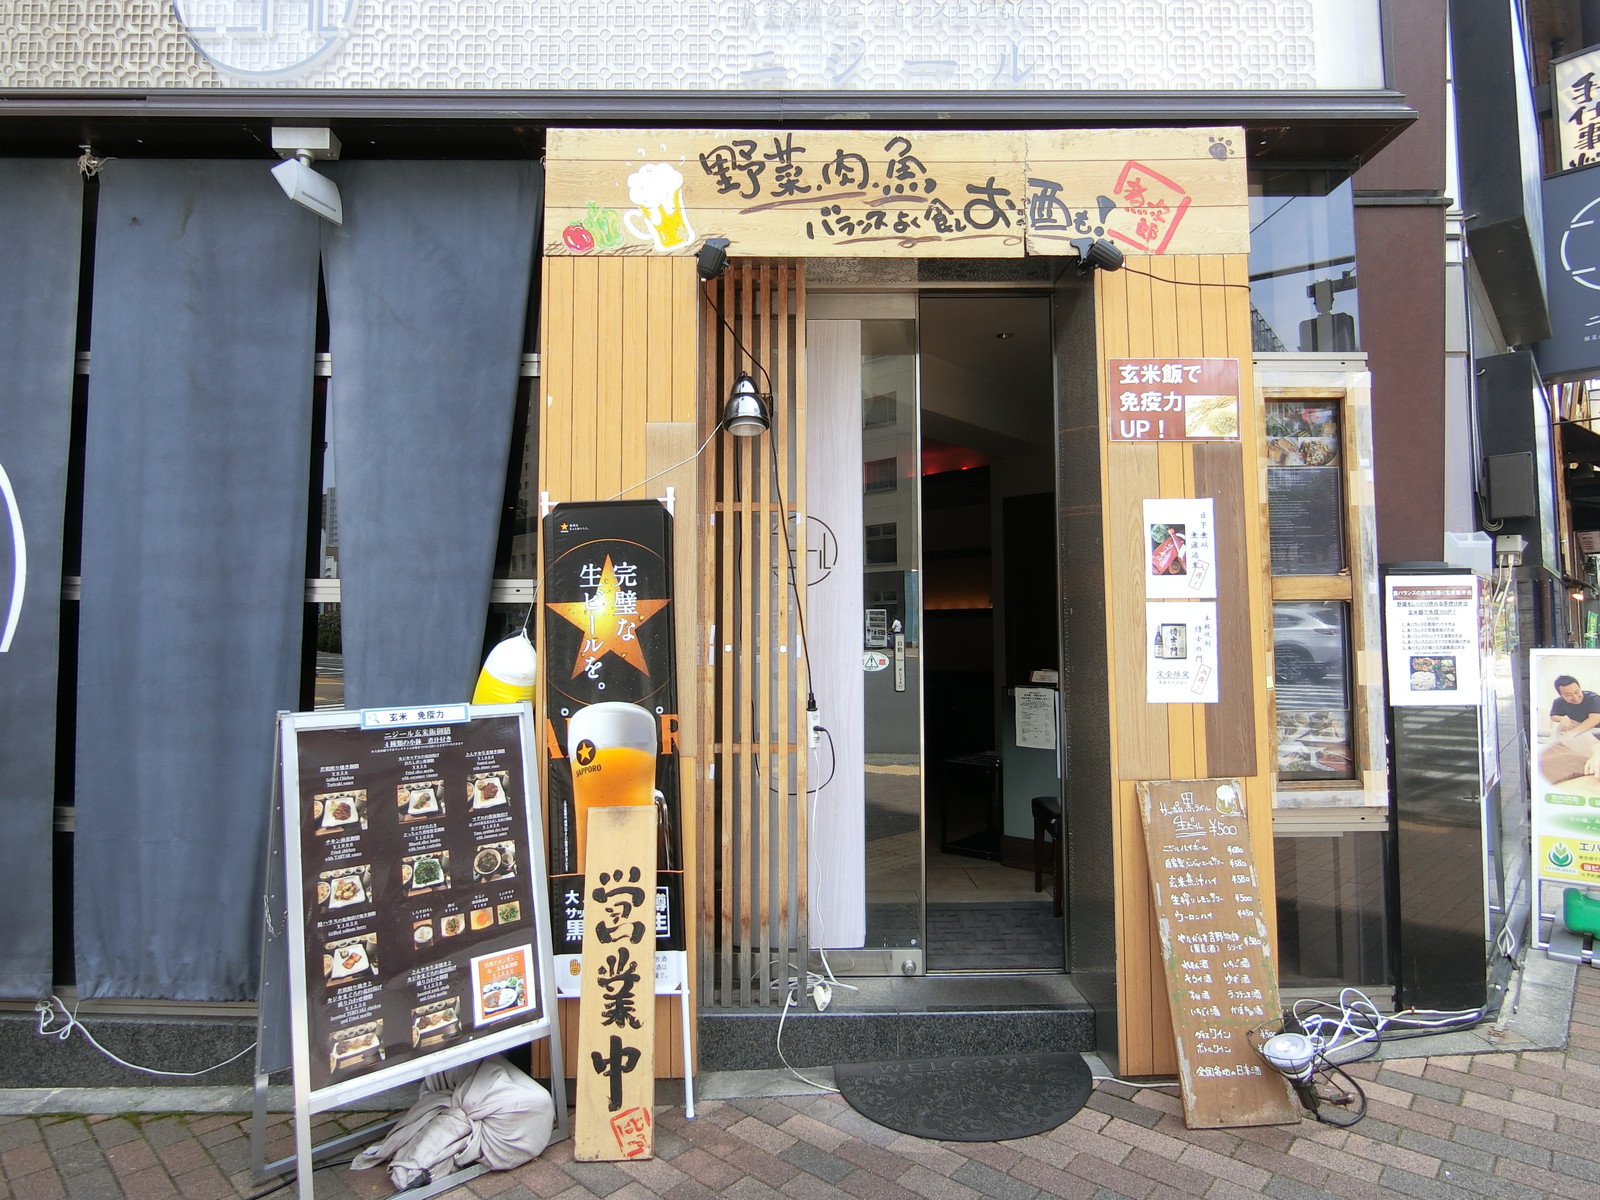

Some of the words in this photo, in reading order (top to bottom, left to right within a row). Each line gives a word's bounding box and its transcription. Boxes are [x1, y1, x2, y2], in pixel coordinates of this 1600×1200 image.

[740, 38, 1037, 84] ニジール
[1119, 363, 1202, 385] 玄米飯で
[1119, 390, 1183, 412] 免疫力
[613, 561, 638, 641] 完璧な
[579, 563, 606, 690] 生ビールを。
[389, 713, 408, 722] 玄米
[417, 710, 445, 720] 免疫力
[575, 763, 602, 778] SAPPORO
[1208, 818, 1237, 836] ¥500
[592, 866, 646, 1112] 営業中
